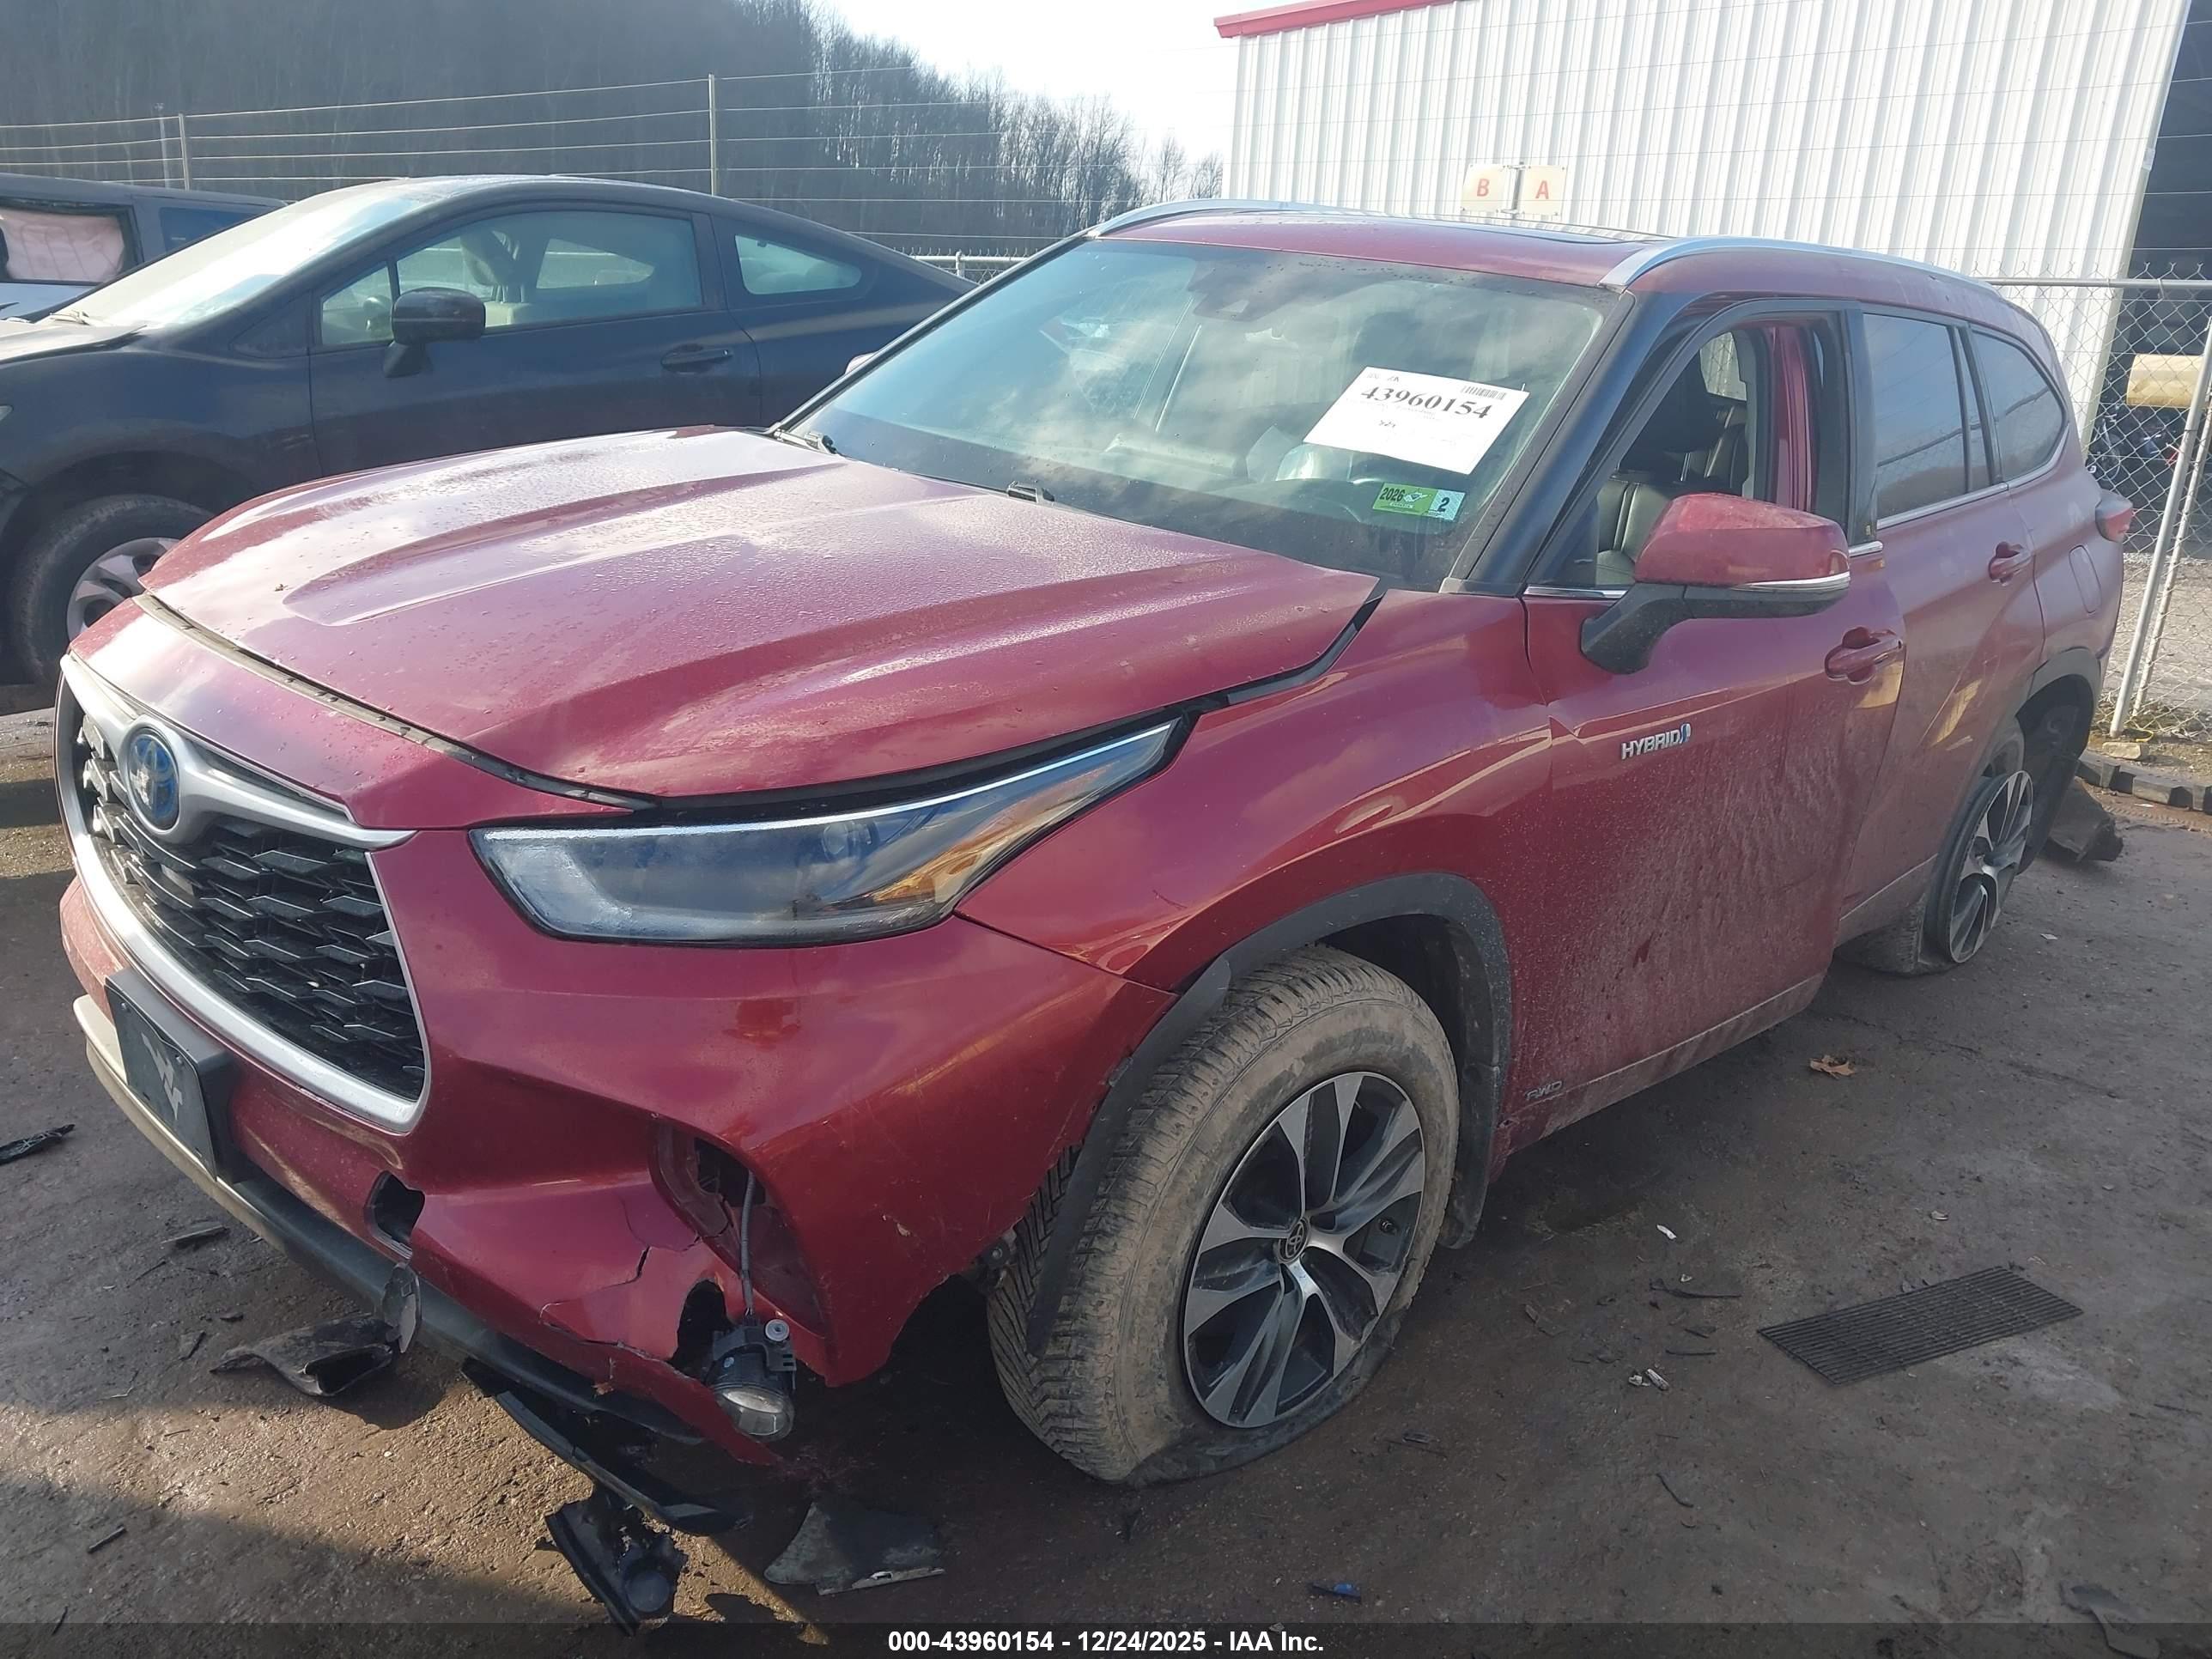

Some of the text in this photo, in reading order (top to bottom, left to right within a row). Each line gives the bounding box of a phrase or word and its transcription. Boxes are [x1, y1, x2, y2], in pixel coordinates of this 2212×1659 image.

[1476, 179, 1490, 197] B
[1535, 180, 1549, 199] A
[1361, 386, 1492, 418] 43960154
[1379, 487, 1406, 502] 2026
[1437, 497, 1450, 513] 2
[1621, 729, 1682, 760] HYBRID
